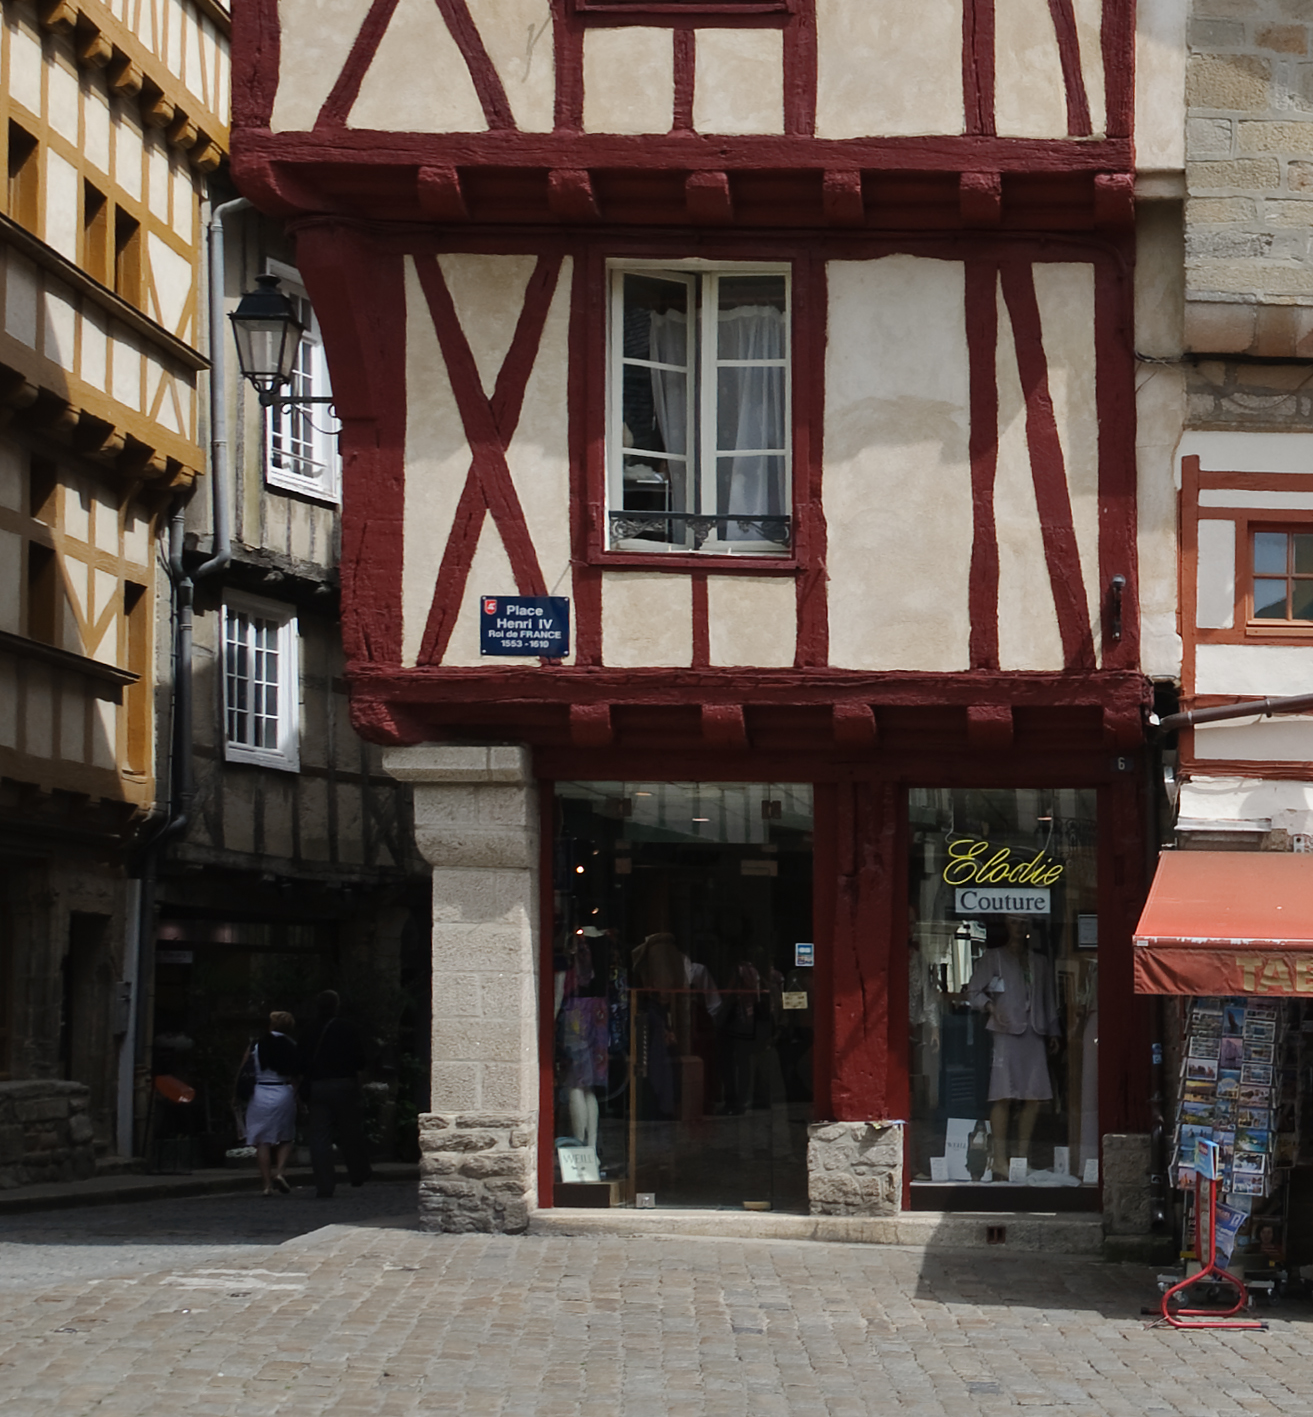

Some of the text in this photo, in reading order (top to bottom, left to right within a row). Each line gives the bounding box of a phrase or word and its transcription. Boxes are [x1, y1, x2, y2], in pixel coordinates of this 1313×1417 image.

[506, 604, 544, 616] Place
[496, 618, 553, 629] Henri IV
[488, 629, 562, 639] Roi de FRANCE
[500, 639, 523, 648] 1553
[529, 640, 550, 648] 1610
[1117, 756, 1126, 771] 6
[943, 839, 1064, 885] Elodie
[960, 890, 1046, 911] Couture
[563, 1153, 593, 1163] WEILL
